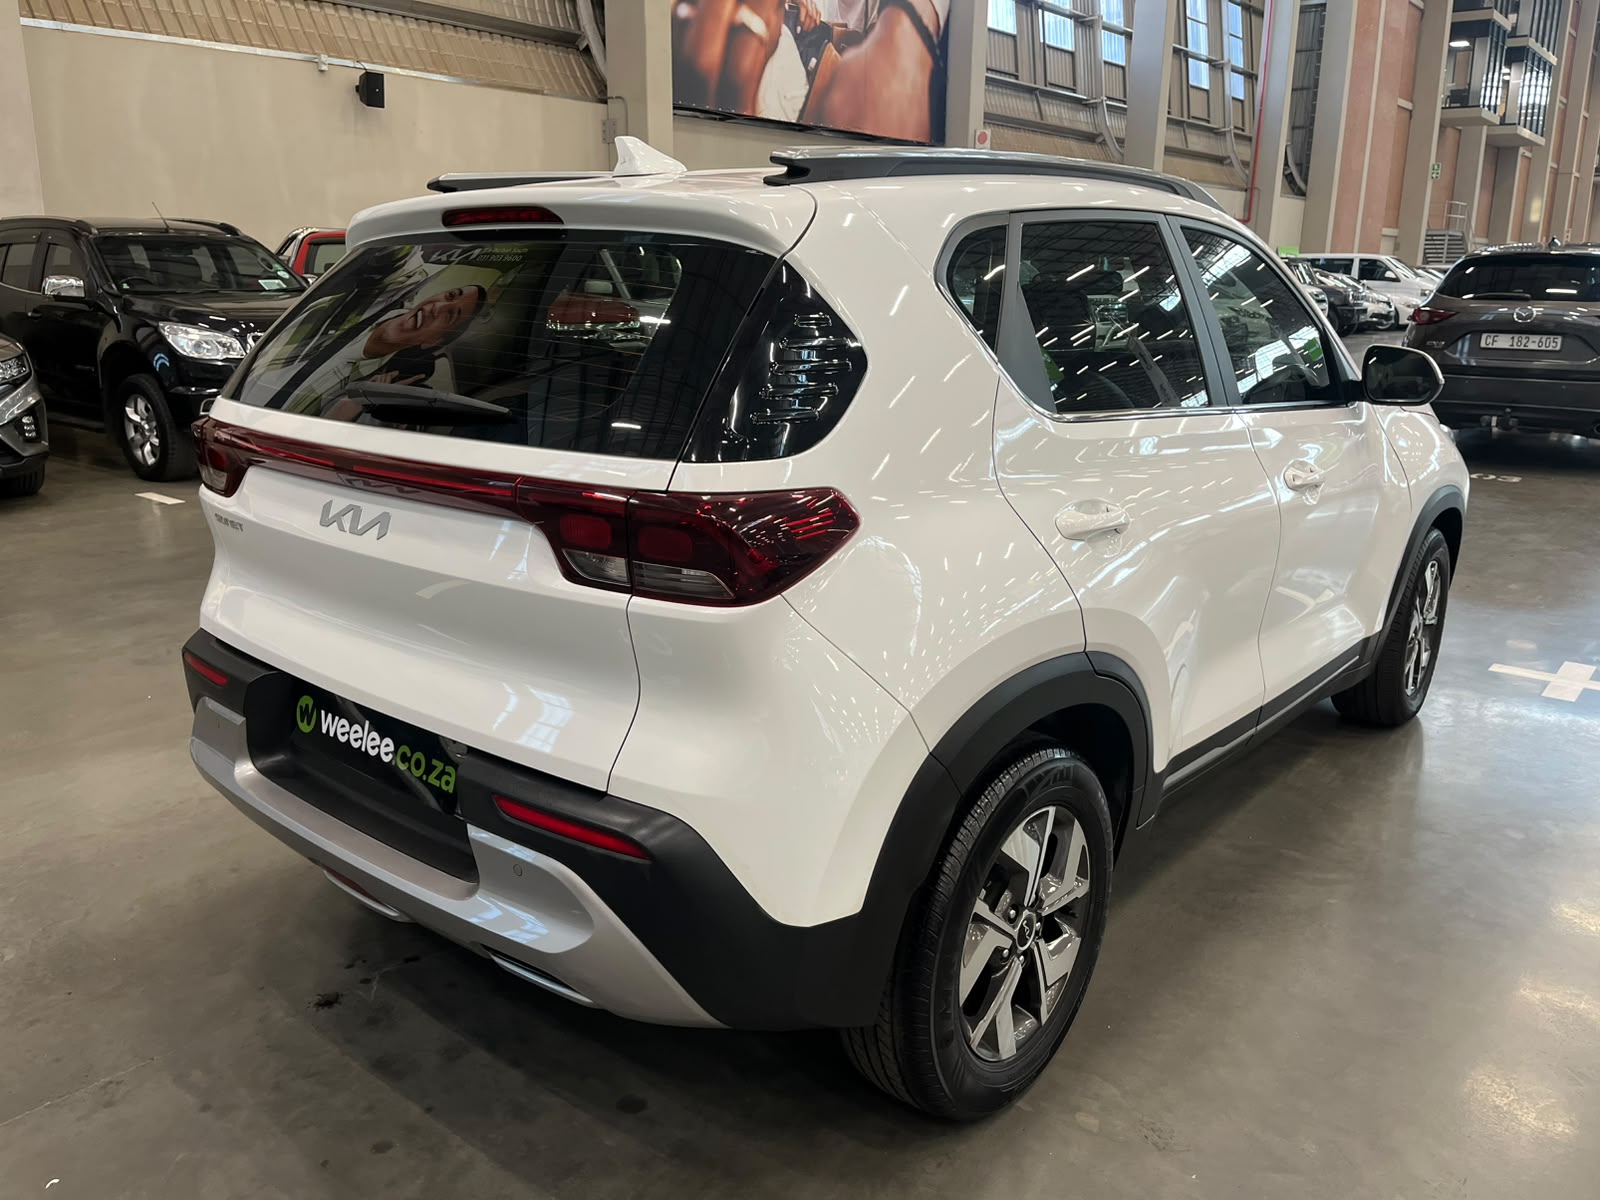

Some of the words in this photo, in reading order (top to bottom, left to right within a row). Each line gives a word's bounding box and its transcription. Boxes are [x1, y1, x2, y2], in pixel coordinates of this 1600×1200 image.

[1484, 334, 1499, 346] CF
[1509, 336, 1559, 349] 182-605
[319, 500, 391, 541] KIA
[321, 709, 456, 793] weelee.co.za
